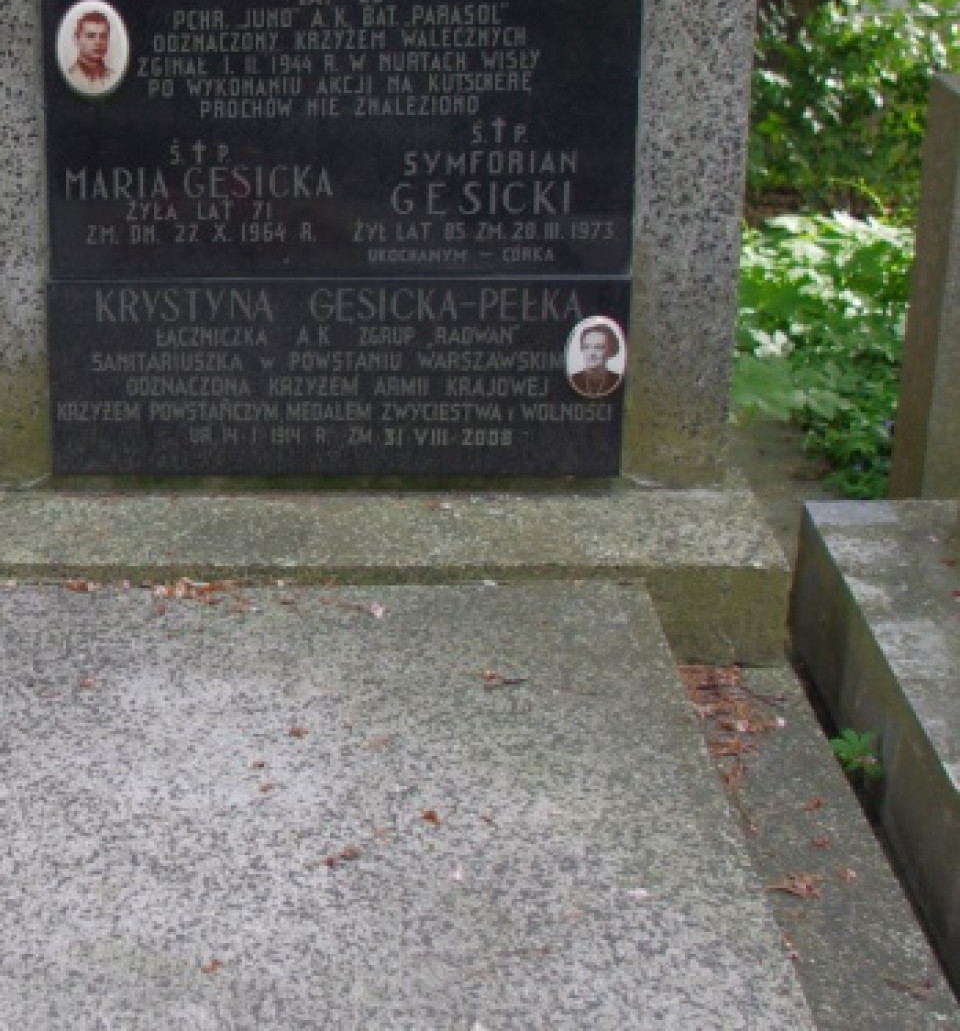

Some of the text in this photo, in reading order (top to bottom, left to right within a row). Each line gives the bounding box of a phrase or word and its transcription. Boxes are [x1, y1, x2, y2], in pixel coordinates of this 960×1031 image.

[153, 26, 528, 53] ODZNACZONY KRZYŻEM WALECZNYCH
[271, 53, 312, 75] 1944
[348, 52, 367, 72] W
[378, 51, 467, 73] NURTACH
[148, 78, 175, 100] PO
[186, 75, 302, 98] WYKONANIU
[316, 74, 373, 95] AKCJI
[387, 74, 414, 94] NA
[306, 96, 341, 118] NIE
[354, 94, 481, 117] ZNALEZIONO
[403, 148, 579, 176] SYMFORIAN
[65, 166, 170, 201] MARIA
[197, 200, 235, 221] LAT
[252, 200, 274, 221] 71
[241, 221, 288, 243] 1964
[395, 220, 434, 242] LAT
[95, 287, 274, 323] KRYSTYNA
[290, 350, 403, 372] POWSTANIU
[373, 375, 430, 397] ARMII
[444, 375, 549, 398] KRAJOWEJ
